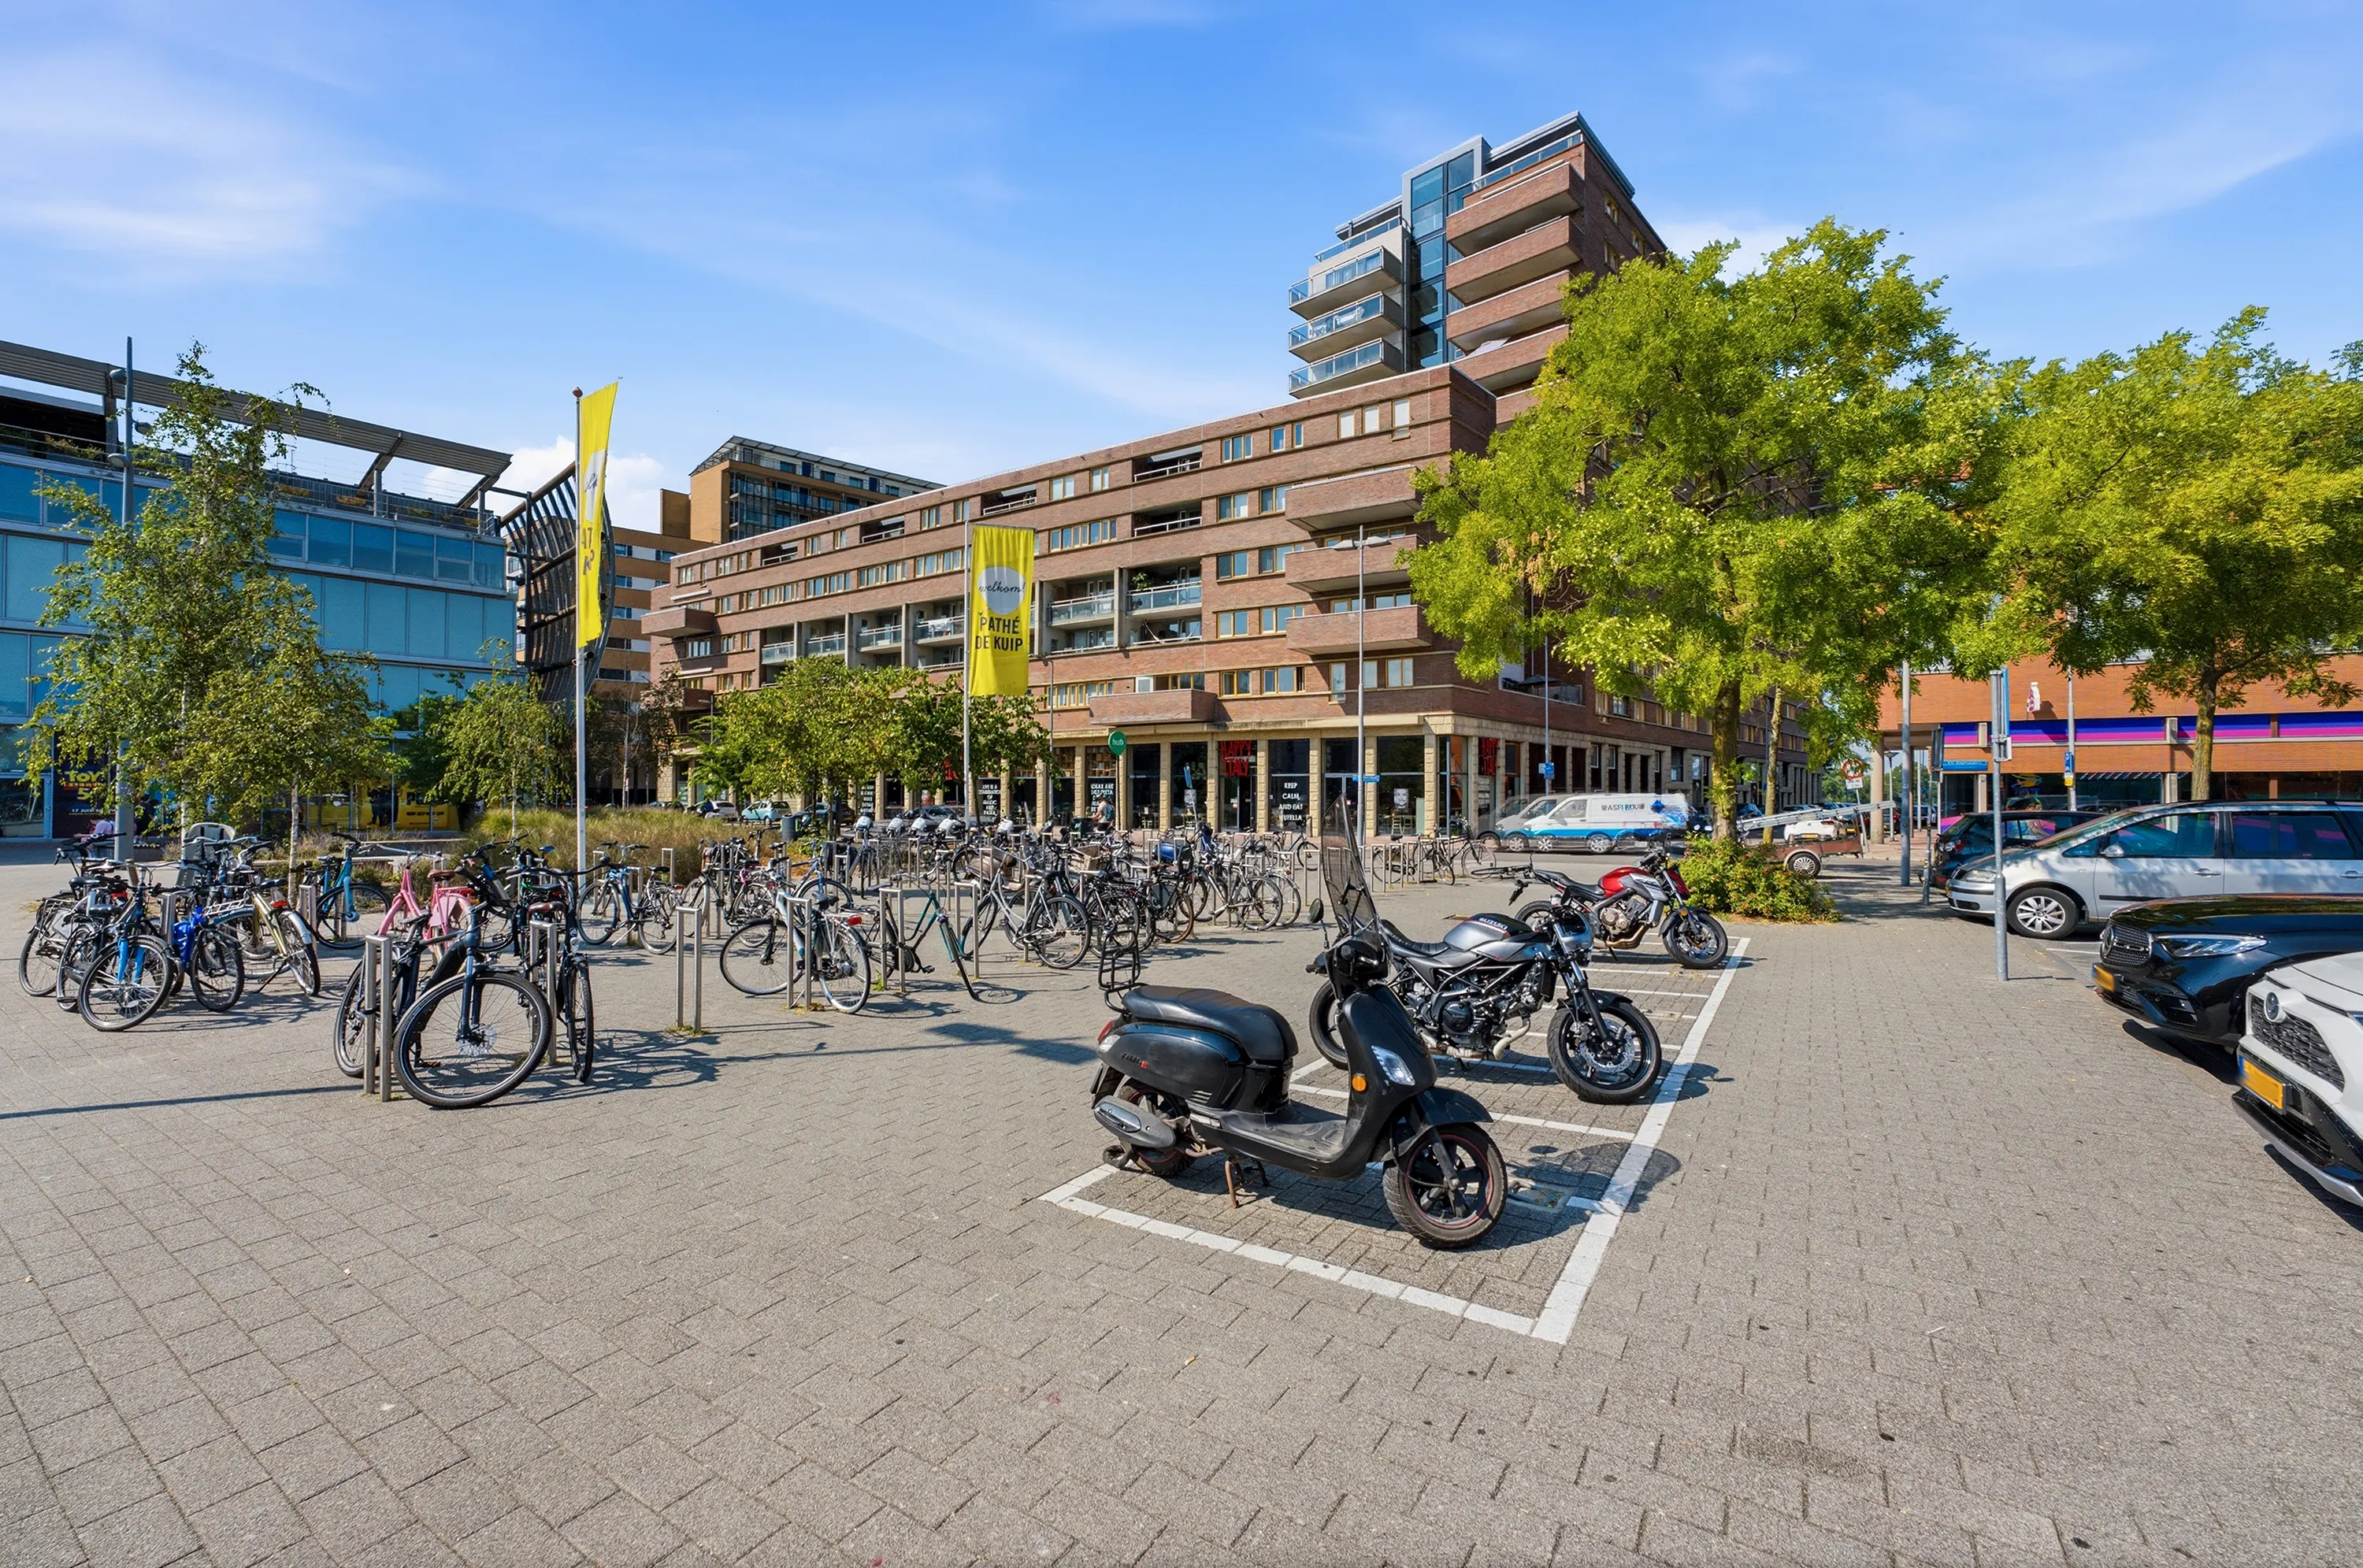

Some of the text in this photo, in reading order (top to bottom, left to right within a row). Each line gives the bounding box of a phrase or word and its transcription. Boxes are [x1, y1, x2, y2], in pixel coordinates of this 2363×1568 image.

[978, 581, 1026, 593] welkom!
[980, 616, 1019, 634] PATHÉ
[975, 636, 1023, 651] DE KUIP
[65, 771, 102, 782] TOY
[77, 788, 91, 800] 5
[1478, 917, 1508, 930] SUZUKI
